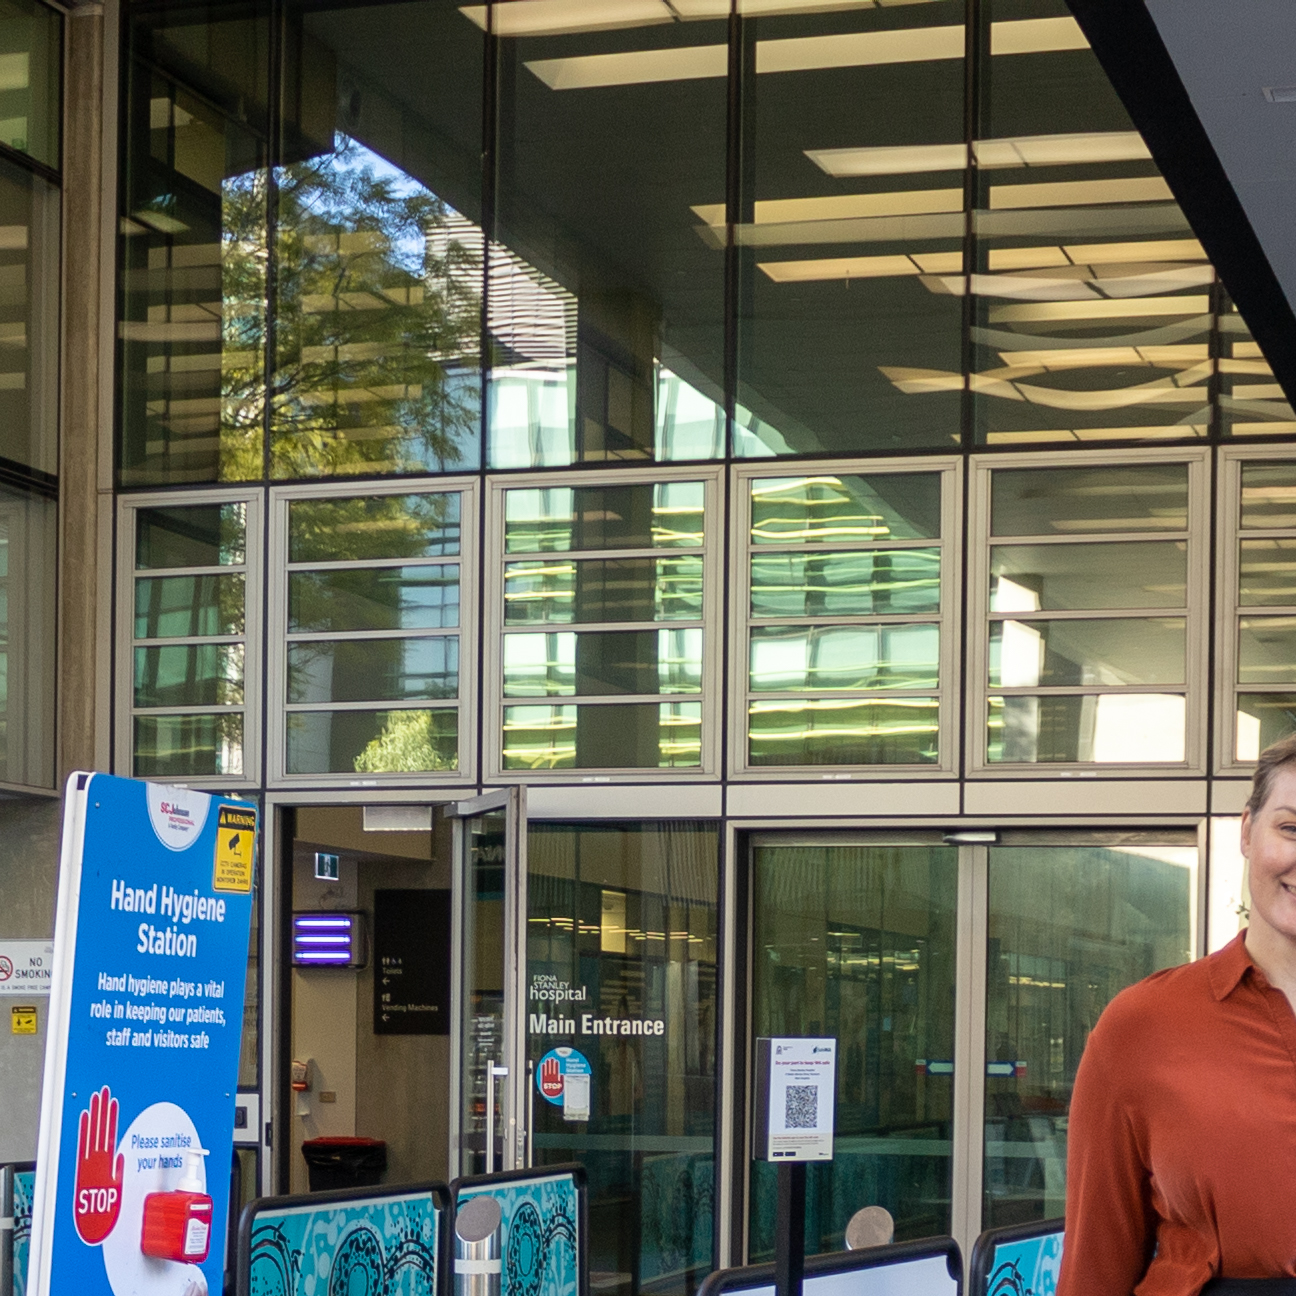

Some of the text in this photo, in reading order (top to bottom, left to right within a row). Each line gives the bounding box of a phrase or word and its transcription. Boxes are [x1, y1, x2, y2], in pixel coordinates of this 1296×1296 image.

[227, 814, 254, 826] WARNING
[111, 879, 226, 924] Hand Hygiene
[137, 923, 197, 958] Station
[30, 957, 42, 966] NO
[15, 970, 52, 978] SMOKIN
[98, 972, 224, 999] Hand hygiene plays a vital
[530, 986, 586, 1004] hospital
[90, 1000, 225, 1027] role in keeping our patients,
[382, 1004, 406, 1012] Vending
[530, 1014, 664, 1035] Main Entrance
[106, 1028, 209, 1049] staff and visitors safe
[131, 1134, 192, 1149] Please sanitise
[137, 1154, 183, 1172] your hands
[78, 1188, 118, 1214] STOP
